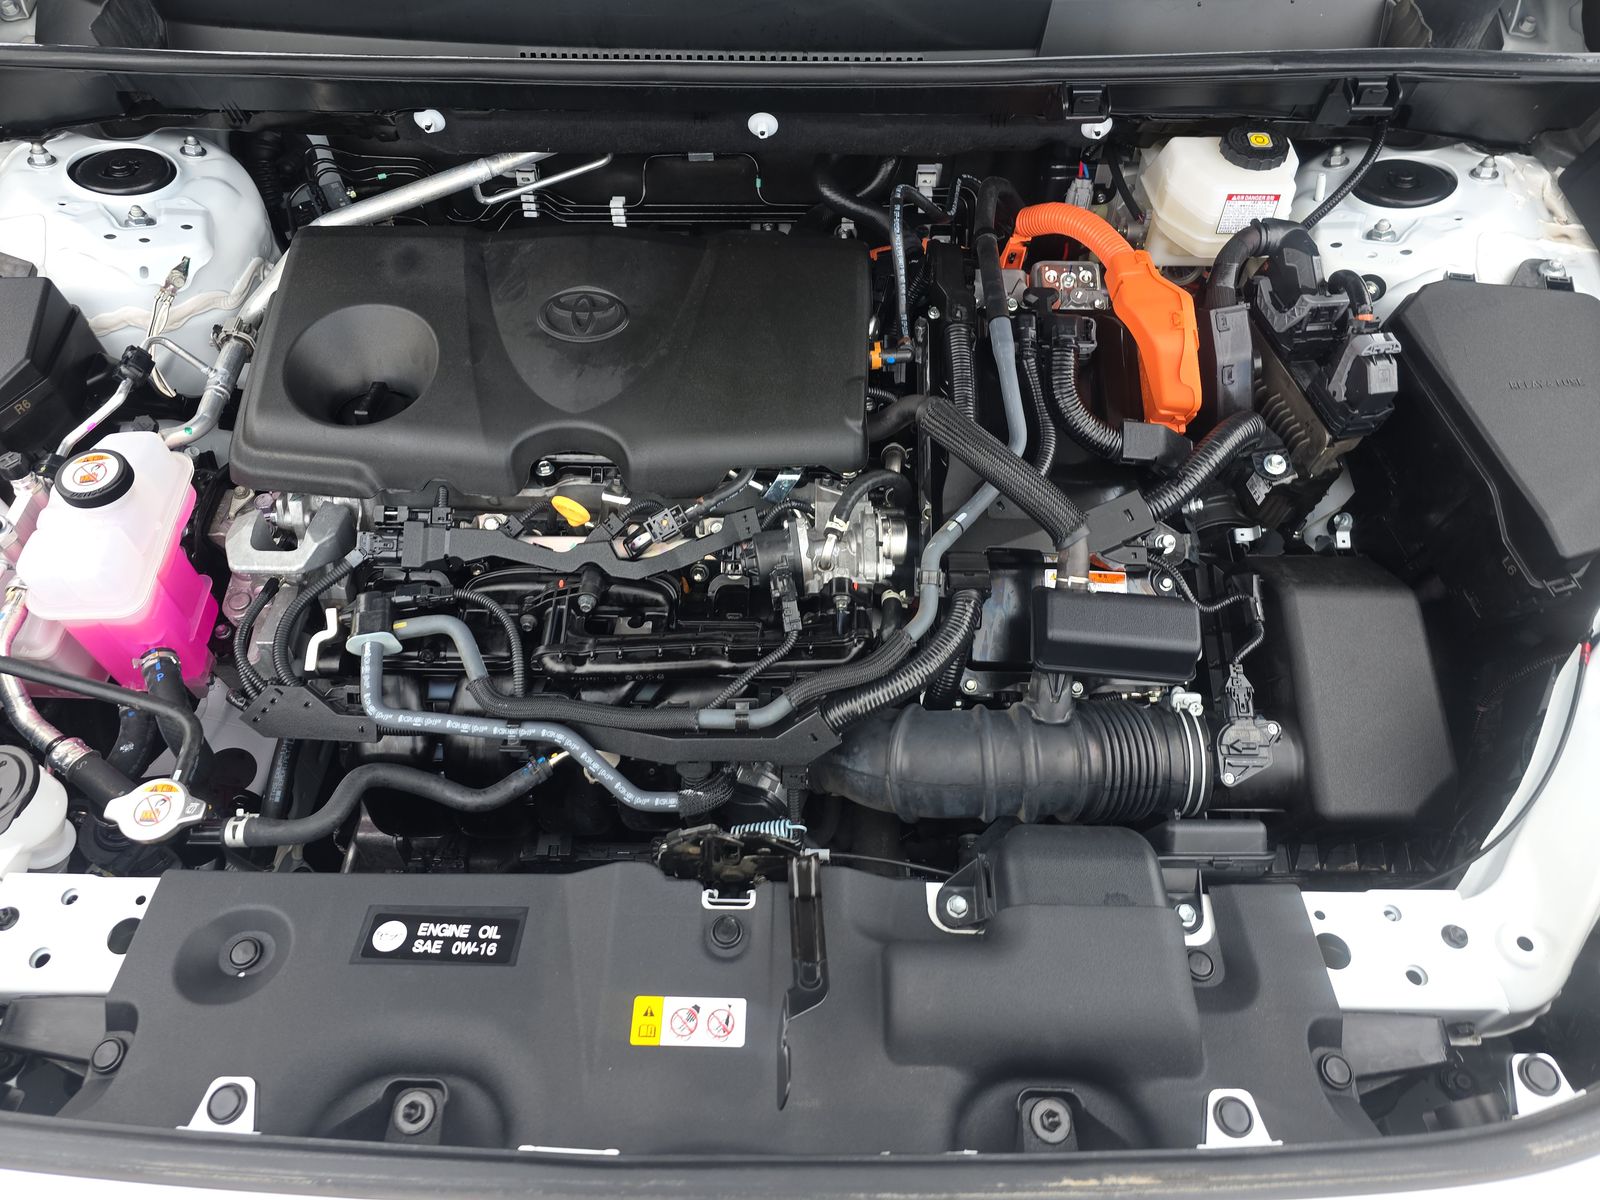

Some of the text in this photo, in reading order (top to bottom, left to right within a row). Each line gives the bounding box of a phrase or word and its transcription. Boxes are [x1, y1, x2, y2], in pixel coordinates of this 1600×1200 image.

[14, 400, 31, 415] R6
[1502, 555, 1517, 577] L6
[417, 922, 471, 938] ENGINE
[478, 925, 501, 940] OIL
[412, 939, 498, 956] SAE 0W-16
